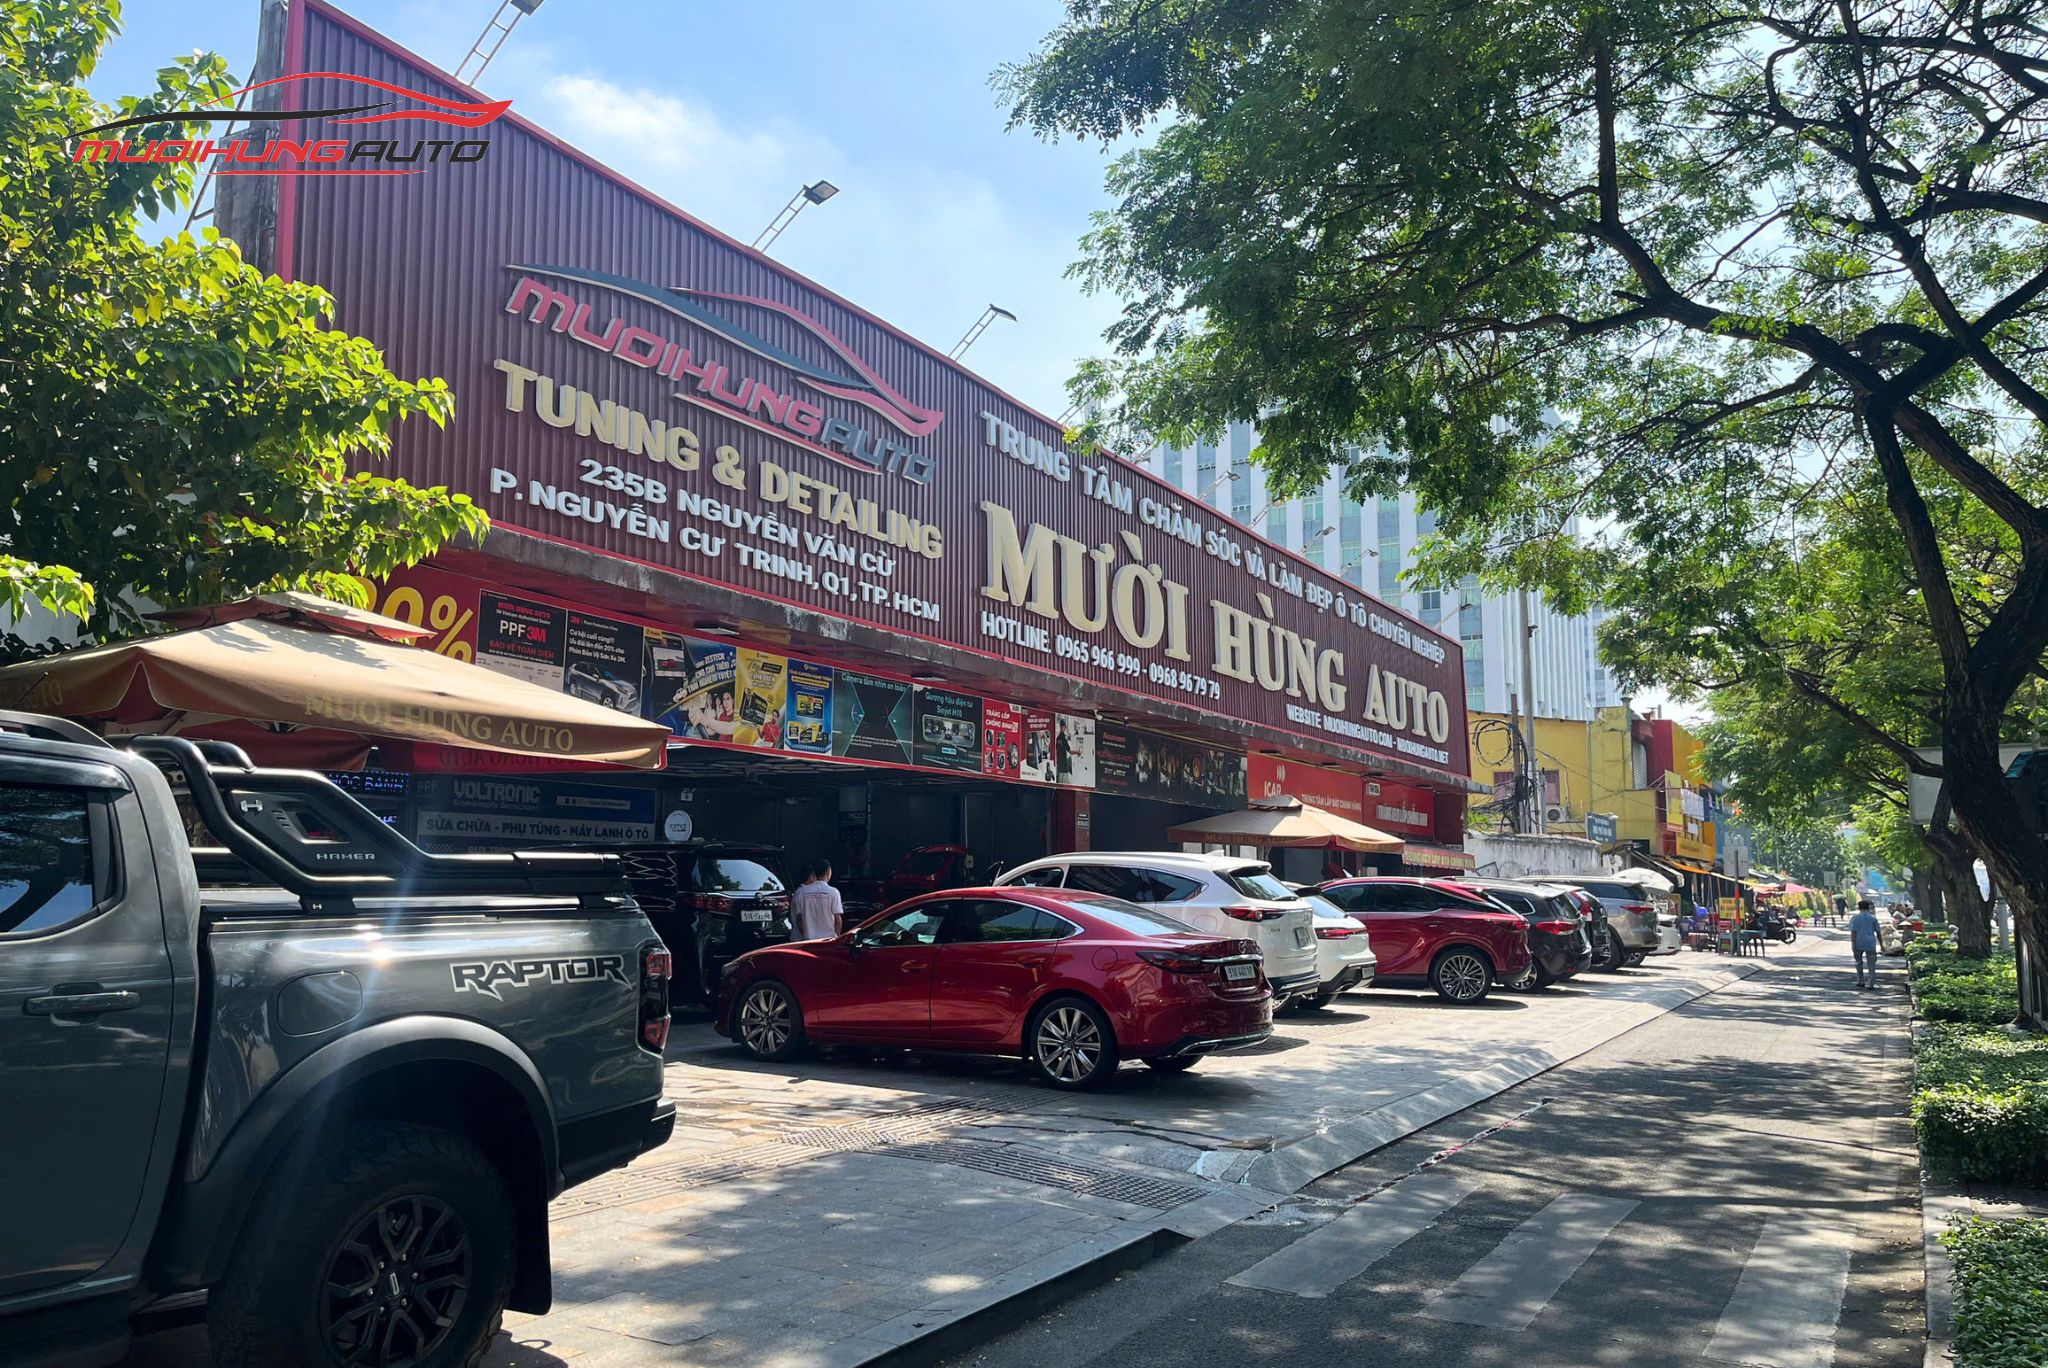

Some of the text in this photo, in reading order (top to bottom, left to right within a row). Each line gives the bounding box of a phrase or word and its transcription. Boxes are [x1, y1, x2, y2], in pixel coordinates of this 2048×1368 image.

[493, 358, 943, 560] TUNING & DETAILING
[578, 458, 896, 577] 235B NGUYỄN VĂN CỪ
[679, 527, 726, 558] CƯ
[980, 410, 1445, 668] TRUNG TÂM CHĂM SÓC VÀ LÀM ĐẸP Ô TÔ CHUYÊN NGHIỆP
[500, 620, 547, 642] PPF 3M
[980, 500, 1449, 744] MƯỜI HÙNG AUTO
[1055, 634, 1089, 664] 0965
[1091, 645, 1115, 671] 966
[1117, 653, 1140, 677] 999
[1149, 662, 1178, 688] 0968
[500, 720, 574, 751] AUTO
[453, 780, 541, 804] VOLTRONIC
[1264, 781, 1282, 797] ICAR
[426, 814, 453, 830] SỬA
[456, 817, 491, 833] CHỮA
[502, 822, 526, 837] PHỤ
[529, 821, 561, 836] TÙNG
[570, 825, 593, 838] MÁY
[594, 827, 624, 842] LẠNH
[625, 825, 634, 838] Ô
[636, 825, 649, 839] TÔ
[450, 955, 633, 1001] RAPTOR
